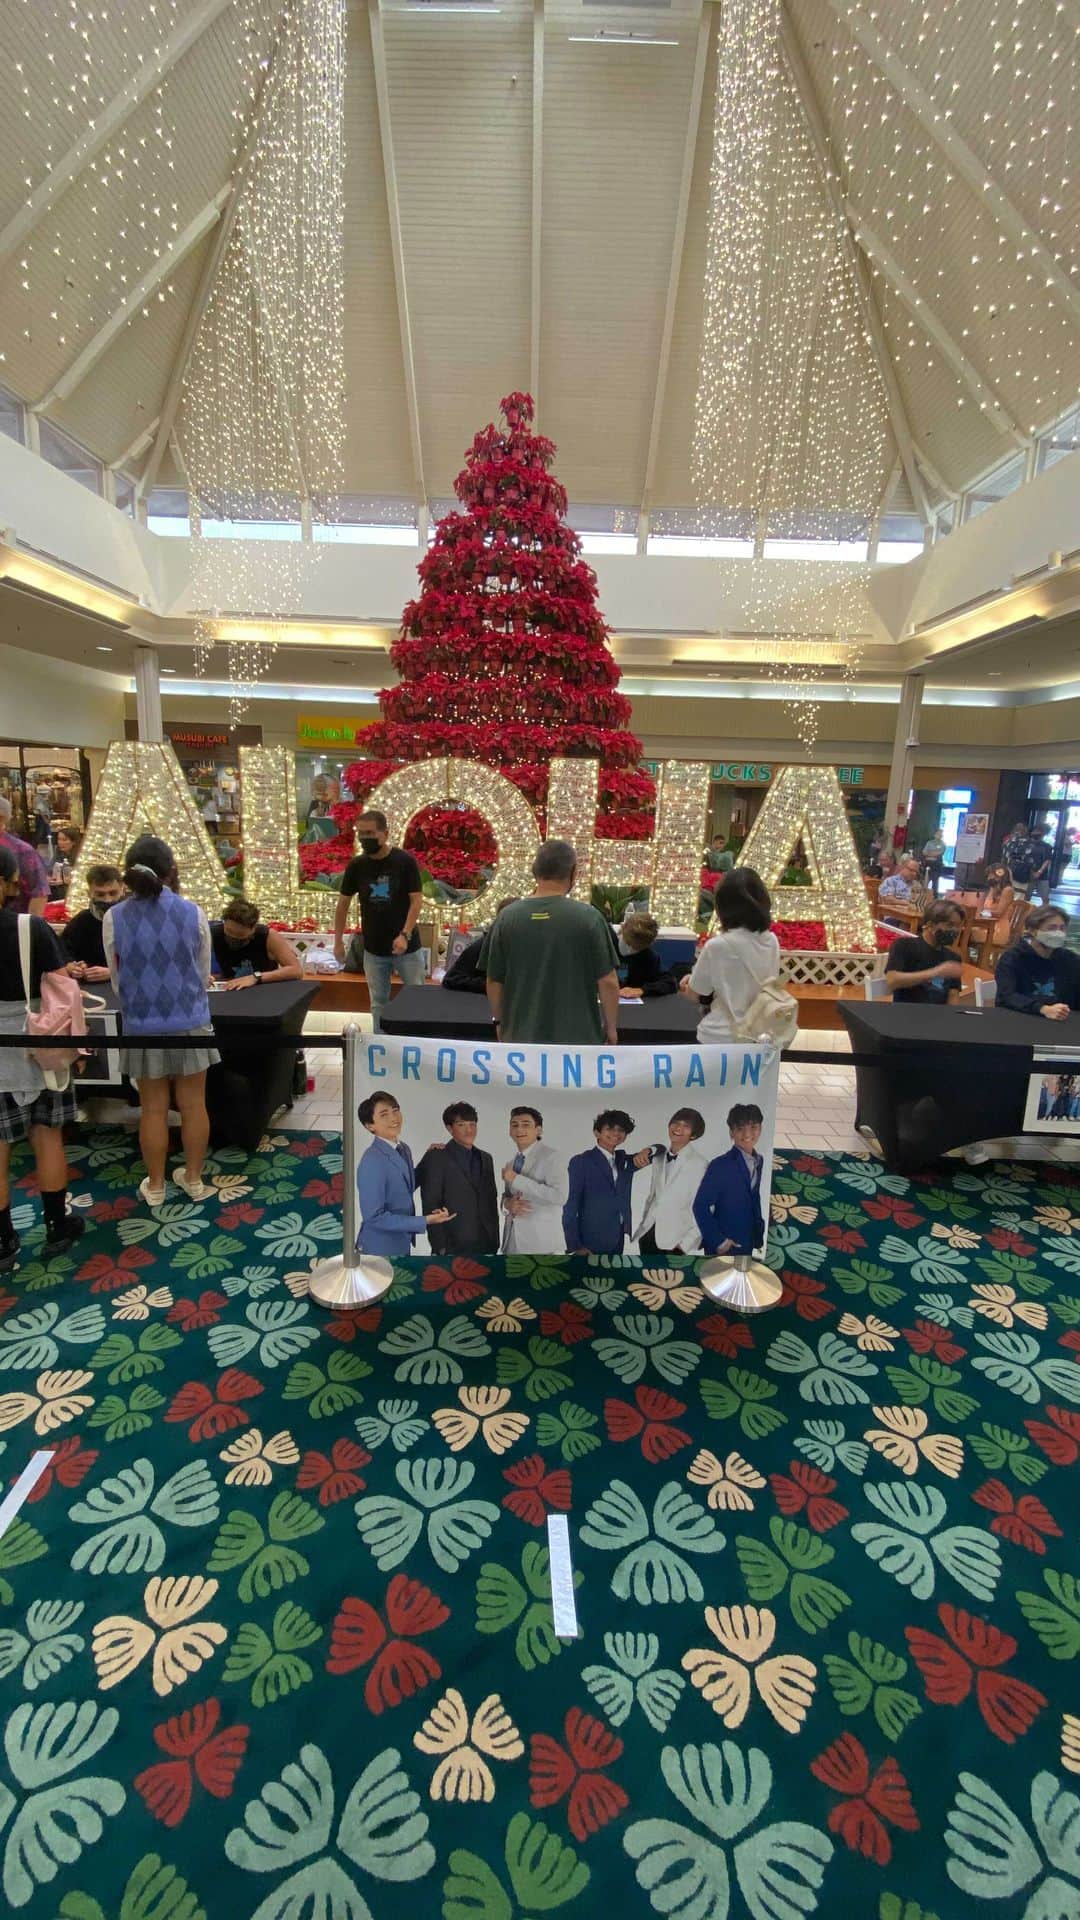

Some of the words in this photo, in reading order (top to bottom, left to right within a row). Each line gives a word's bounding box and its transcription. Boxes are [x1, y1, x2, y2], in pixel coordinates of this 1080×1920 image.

[641, 761, 772, 783] TUCKS
[66, 740, 877, 953] ALOHA
[367, 1043, 617, 1089] CROSSING
[654, 1052, 762, 1089] RAIN
